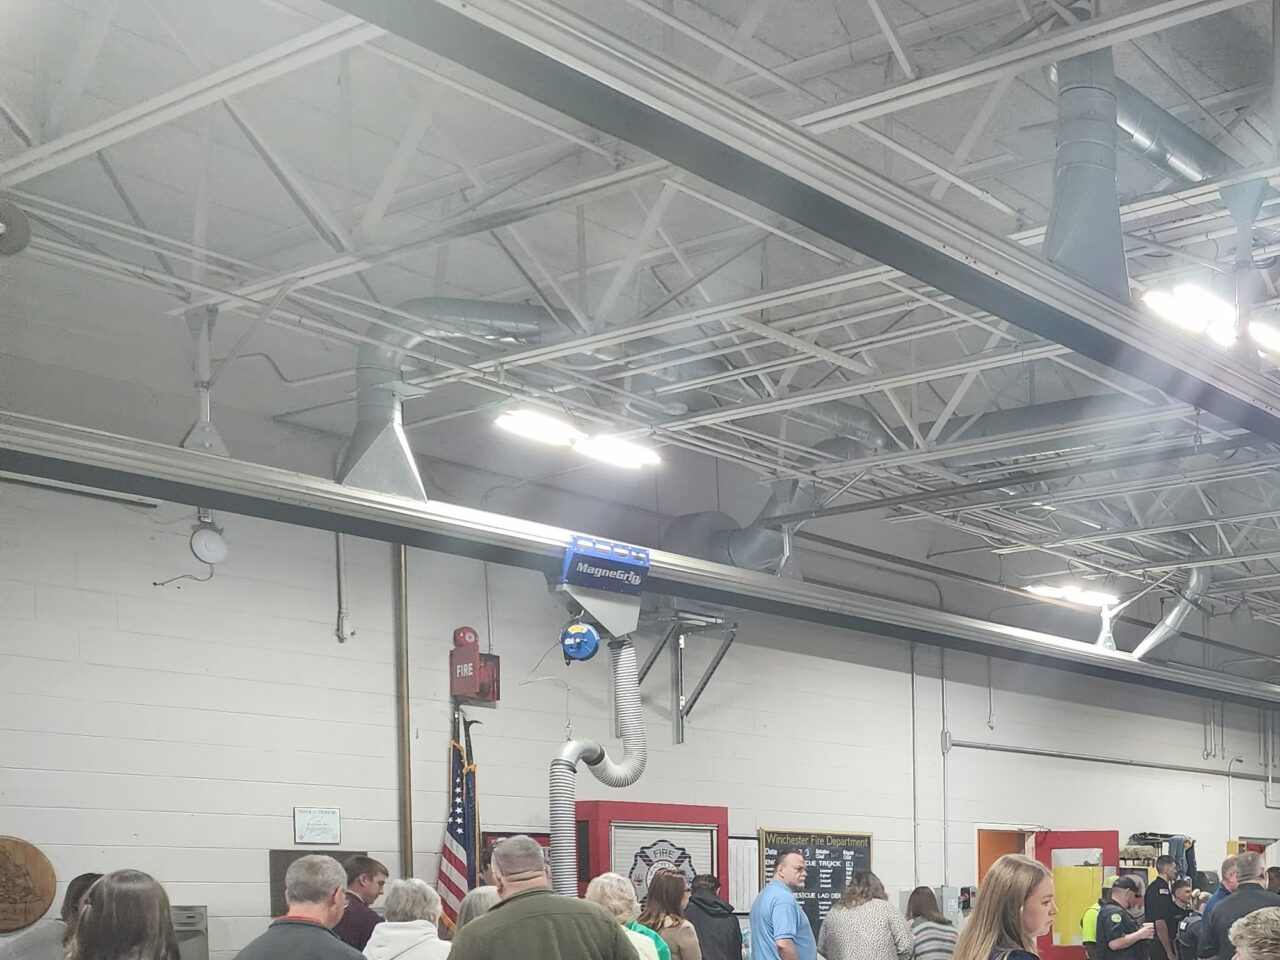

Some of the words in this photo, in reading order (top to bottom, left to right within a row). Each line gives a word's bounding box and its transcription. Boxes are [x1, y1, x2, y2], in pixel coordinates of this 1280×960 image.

[576, 562, 642, 585] MagneGrip
[456, 662, 473, 678] FIRE
[766, 833, 808, 846] Winchester
[811, 834, 824, 846] Fire
[826, 836, 868, 848] Department
[653, 848, 675, 859] FIRE
[765, 847, 777, 855] Date
